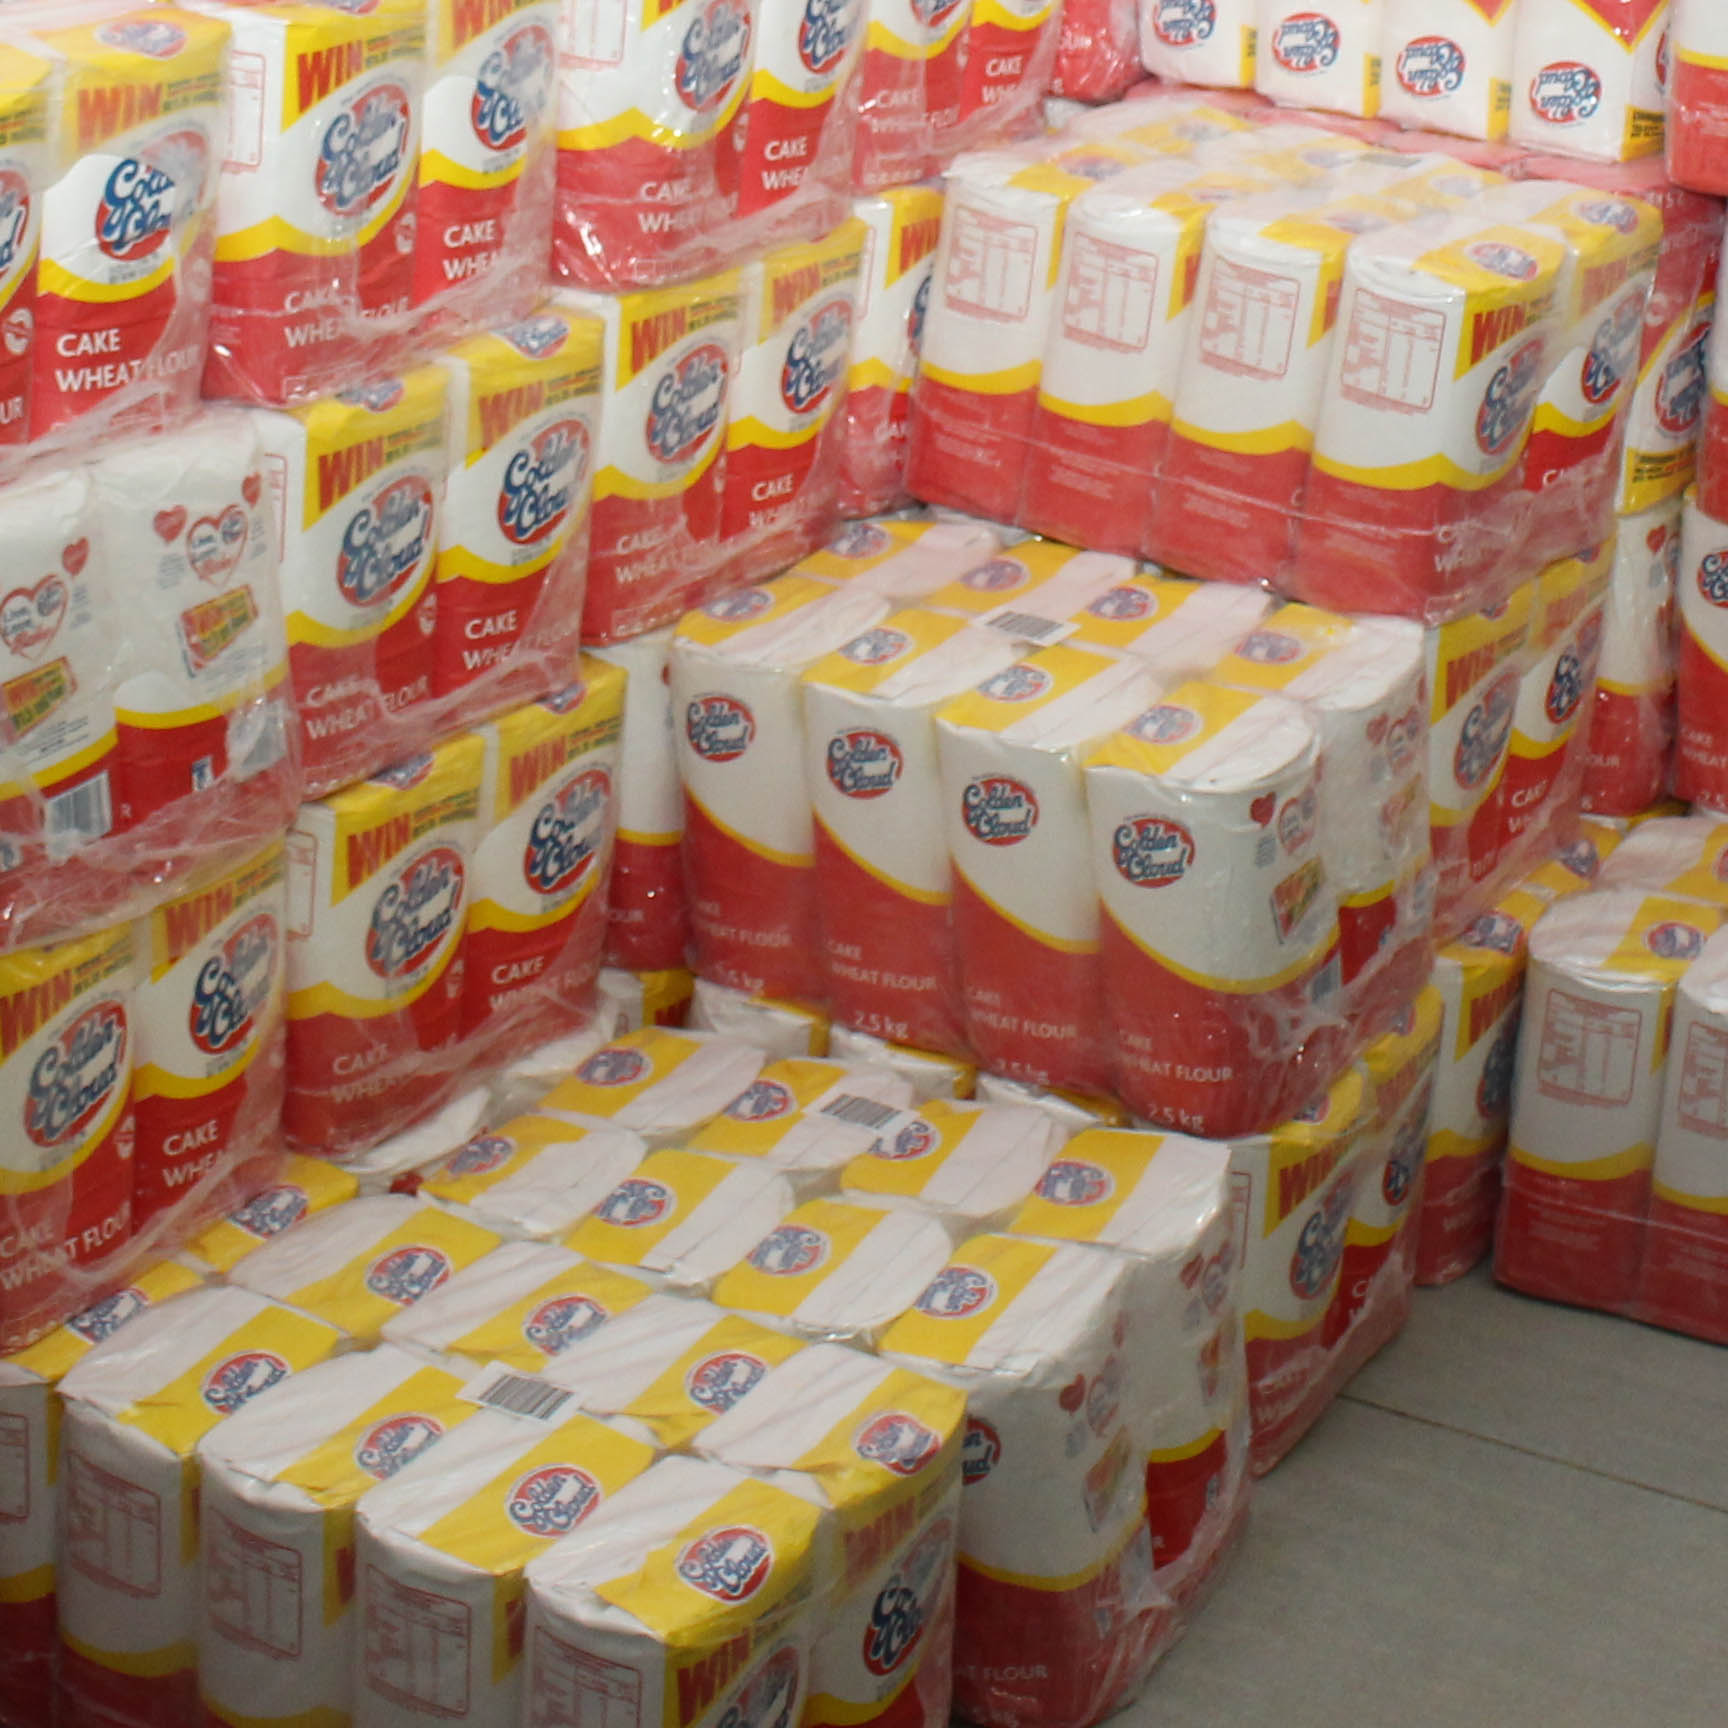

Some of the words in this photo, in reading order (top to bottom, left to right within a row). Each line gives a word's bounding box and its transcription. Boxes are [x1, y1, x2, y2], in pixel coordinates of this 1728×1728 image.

[297, 40, 364, 114] WIN
[986, 57, 1023, 77] CAKE
[78, 84, 162, 149] WIN
[764, 136, 808, 162] CAKE
[443, 218, 497, 249] CAKE
[56, 327, 122, 359] CAKE
[630, 305, 686, 375] WIN
[55, 363, 140, 394] WHEAT
[478, 379, 544, 451] WIN
[319, 435, 386, 514] WIN
[751, 473, 794, 501] CAKE
[464, 610, 518, 638] CAKE
[687, 698, 741, 752] Golden
[697, 724, 750, 757] Cloud
[509, 737, 567, 809] WIN
[826, 728, 888, 785] Golden
[962, 778, 1023, 831] Golden
[975, 804, 1032, 839] Cloud
[346, 812, 412, 889] WIN
[1114, 821, 1178, 876] Golden
[1128, 848, 1190, 880] Cloud
[164, 879, 236, 966] WIN
[491, 956, 545, 985] CAKE
[889, 972, 937, 993] FLOUR
[884, 1018, 909, 1039] kg
[1174, 1061, 1233, 1084] FLOUR
[1179, 1107, 1204, 1130] kg
[162, 1120, 220, 1156] CAKE
[84, 1200, 132, 1251] FLOUR
